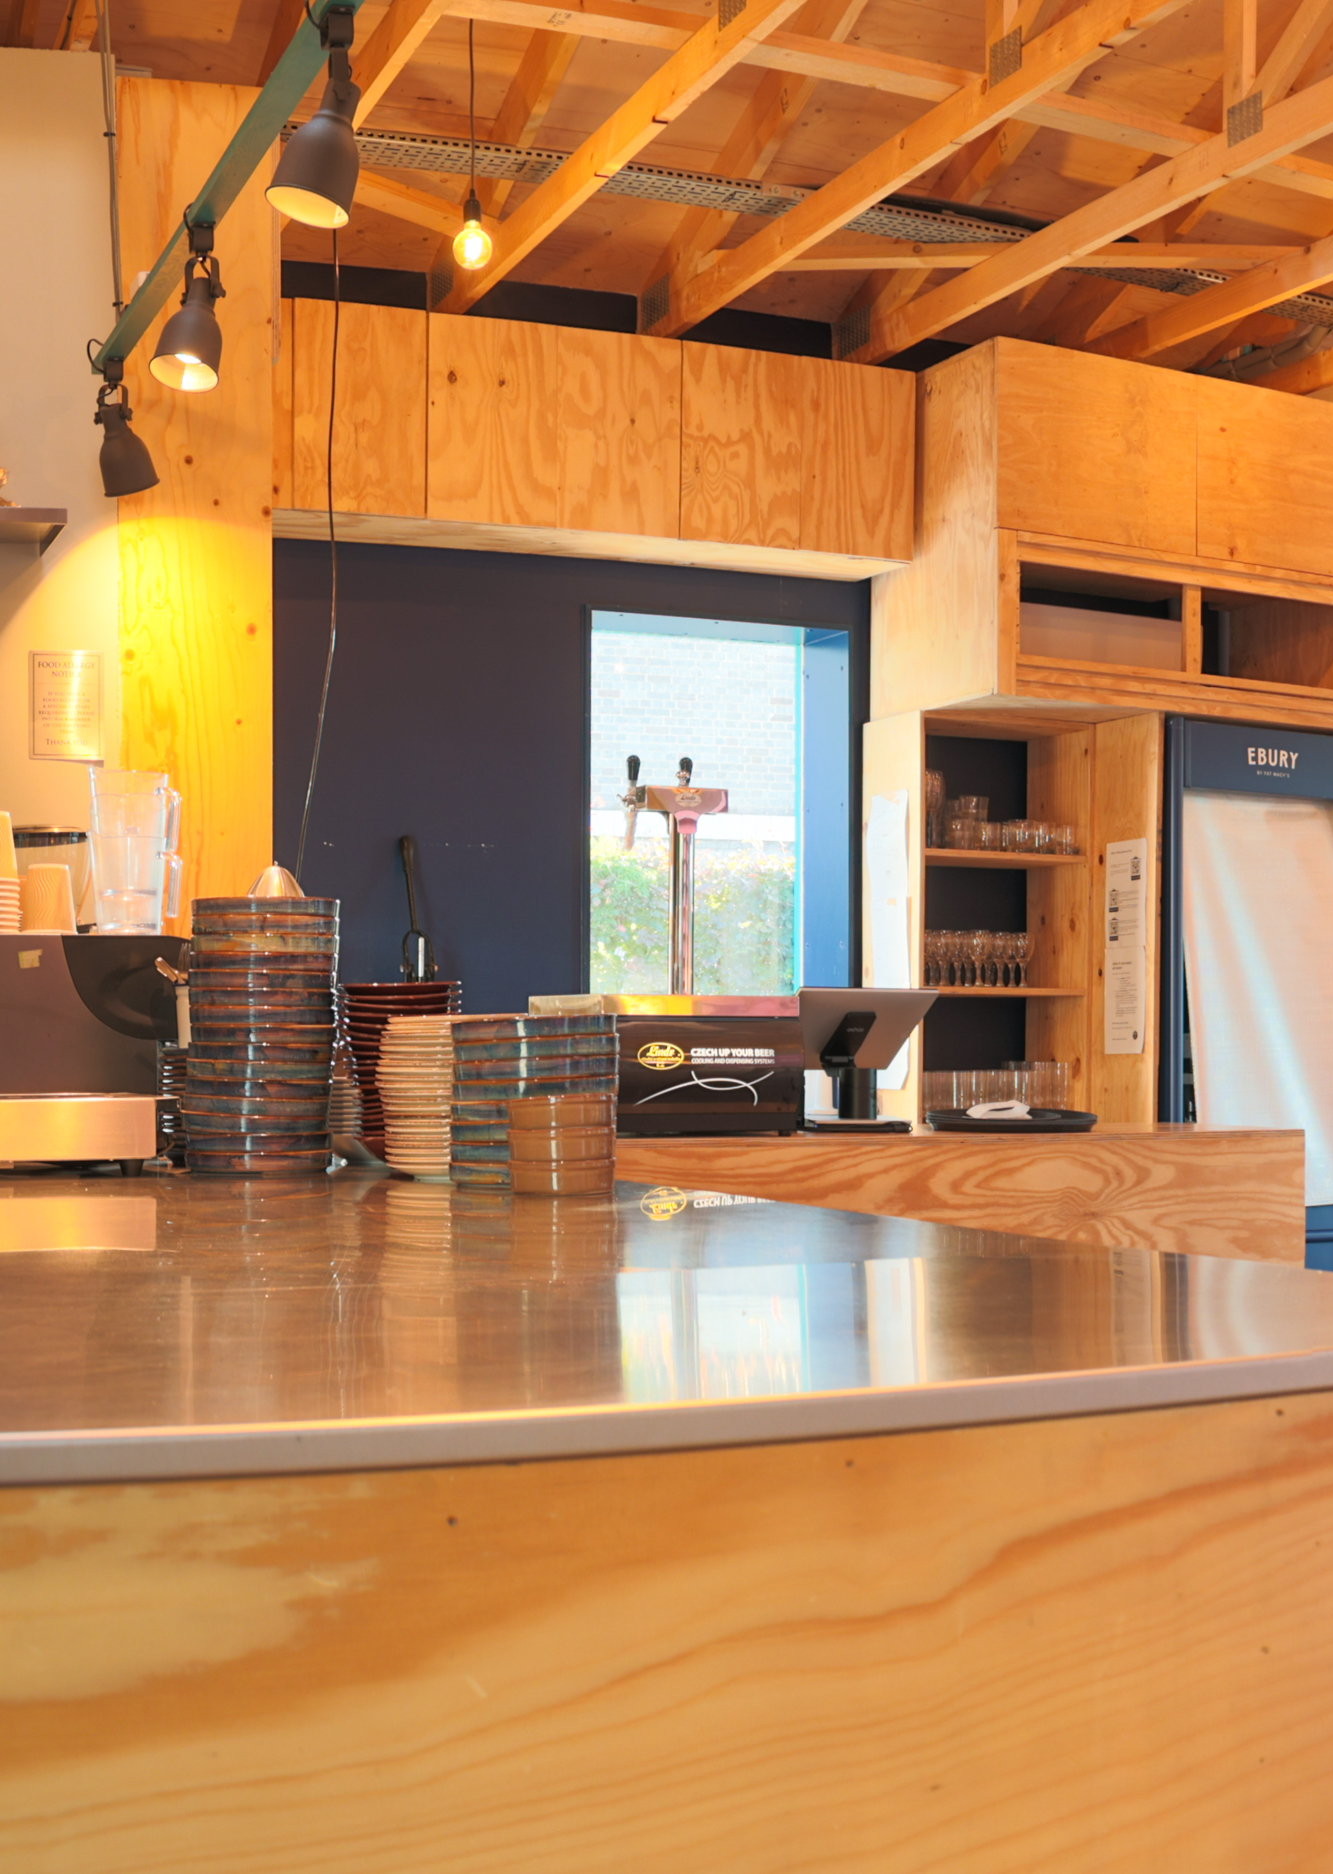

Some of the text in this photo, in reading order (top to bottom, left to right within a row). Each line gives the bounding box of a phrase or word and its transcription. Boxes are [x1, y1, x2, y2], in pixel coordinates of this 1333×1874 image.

[37, 661, 96, 670] FOOD ALLRGY
[1247, 747, 1299, 769] EBURY
[690, 1048, 775, 1057] CZECH UP YOUR BEER
